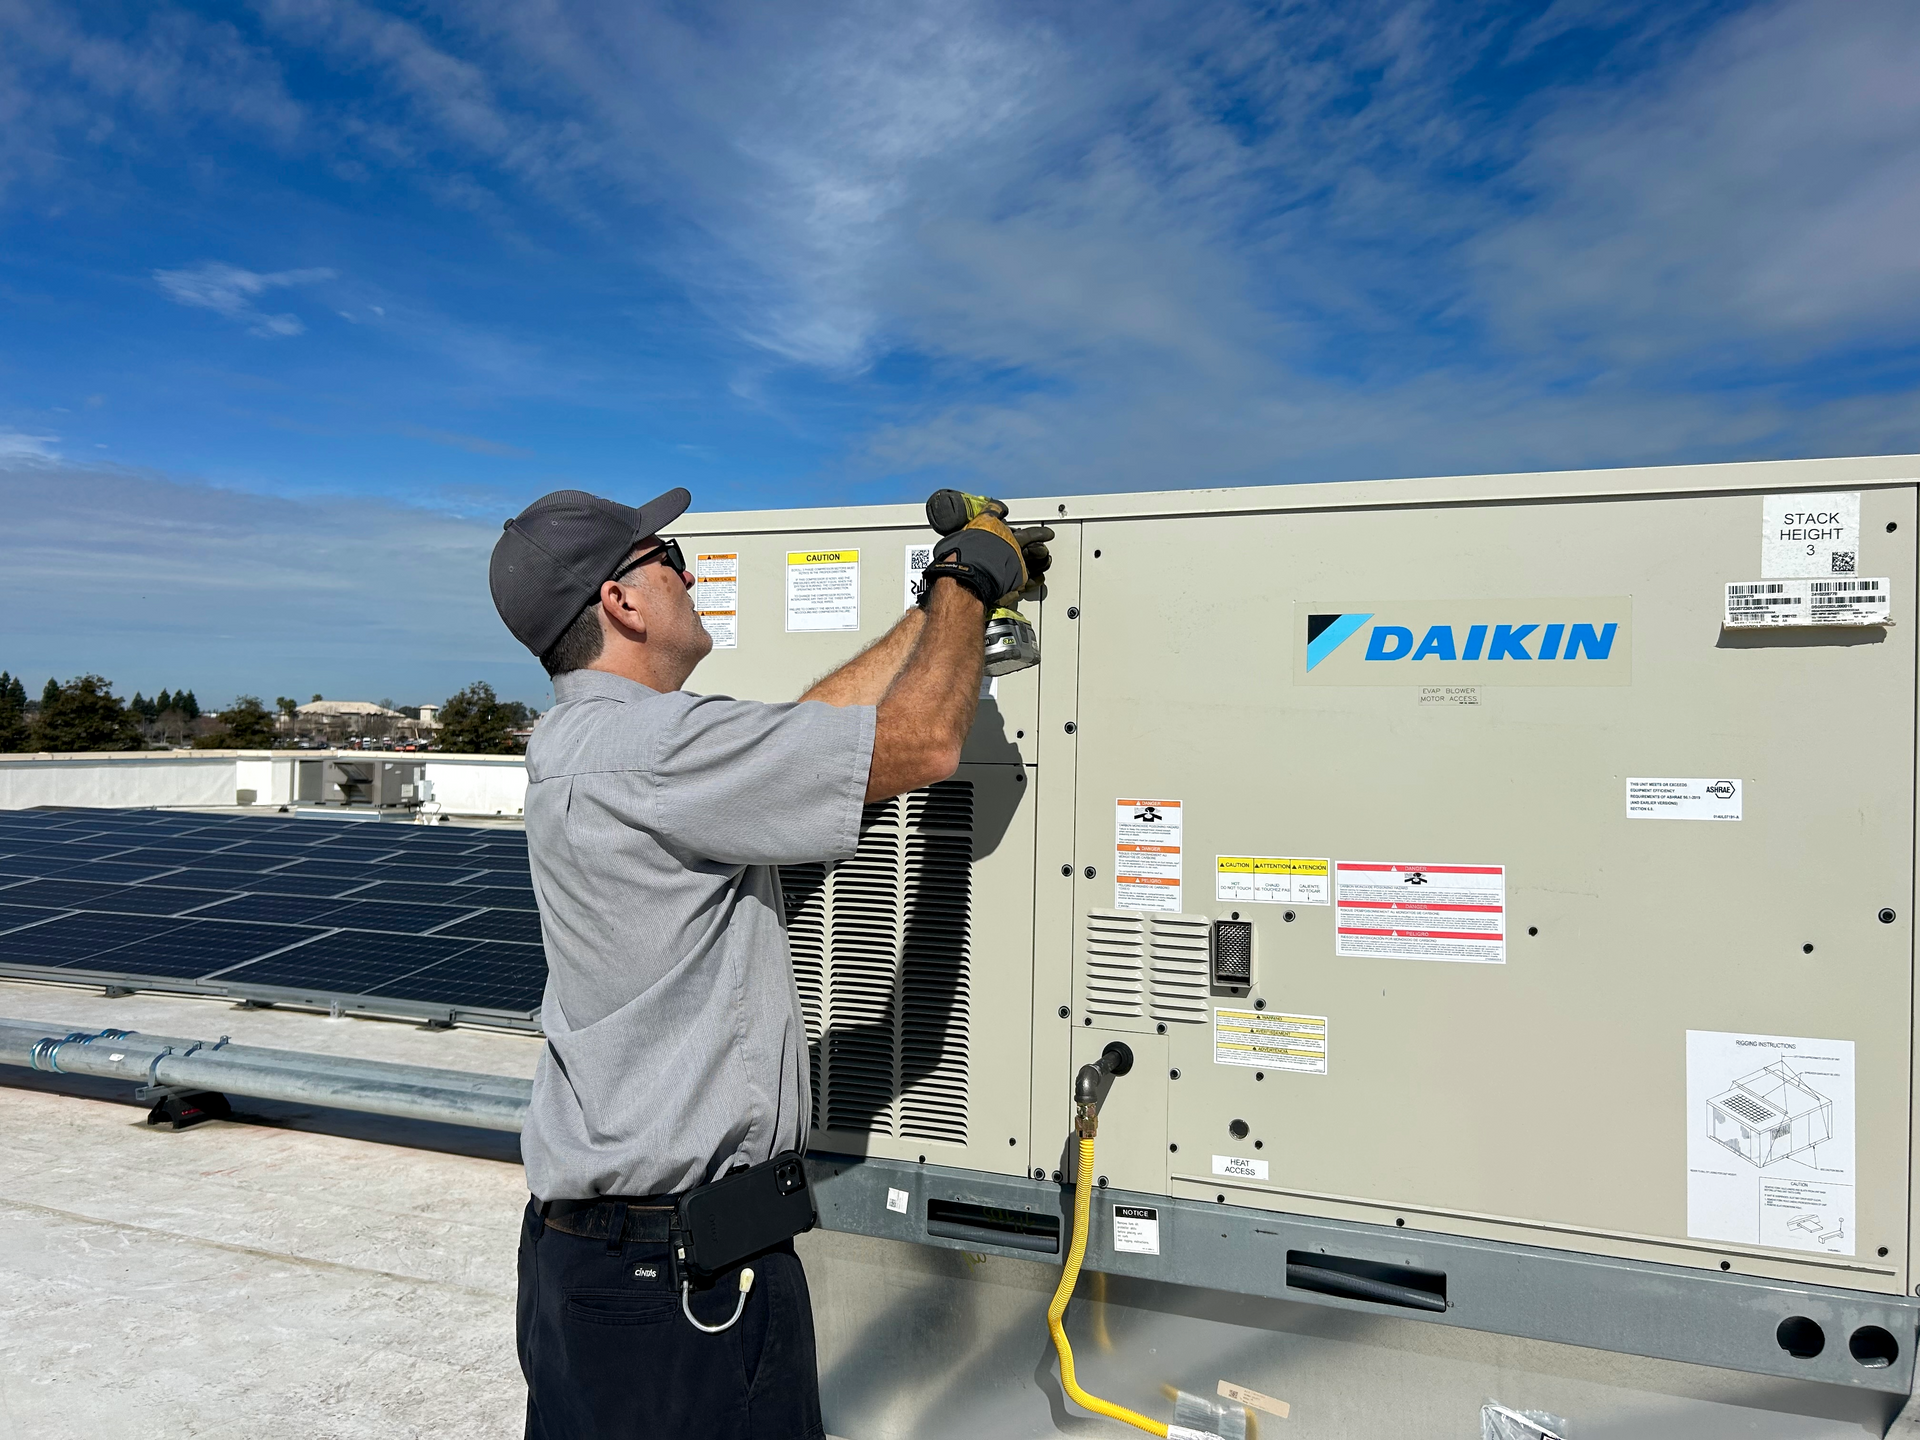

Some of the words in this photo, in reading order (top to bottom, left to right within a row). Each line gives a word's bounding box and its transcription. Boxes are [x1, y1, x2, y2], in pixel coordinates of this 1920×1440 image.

[1784, 512, 1840, 525] STACK
[1780, 528, 1844, 540] HEIGHT
[1806, 544, 1816, 556] 3
[806, 553, 840, 561] CAUTION
[1365, 622, 1618, 661] DAIKIN
[1230, 1159, 1250, 1167] HEAT
[1225, 1166, 1256, 1176] ACCESS
